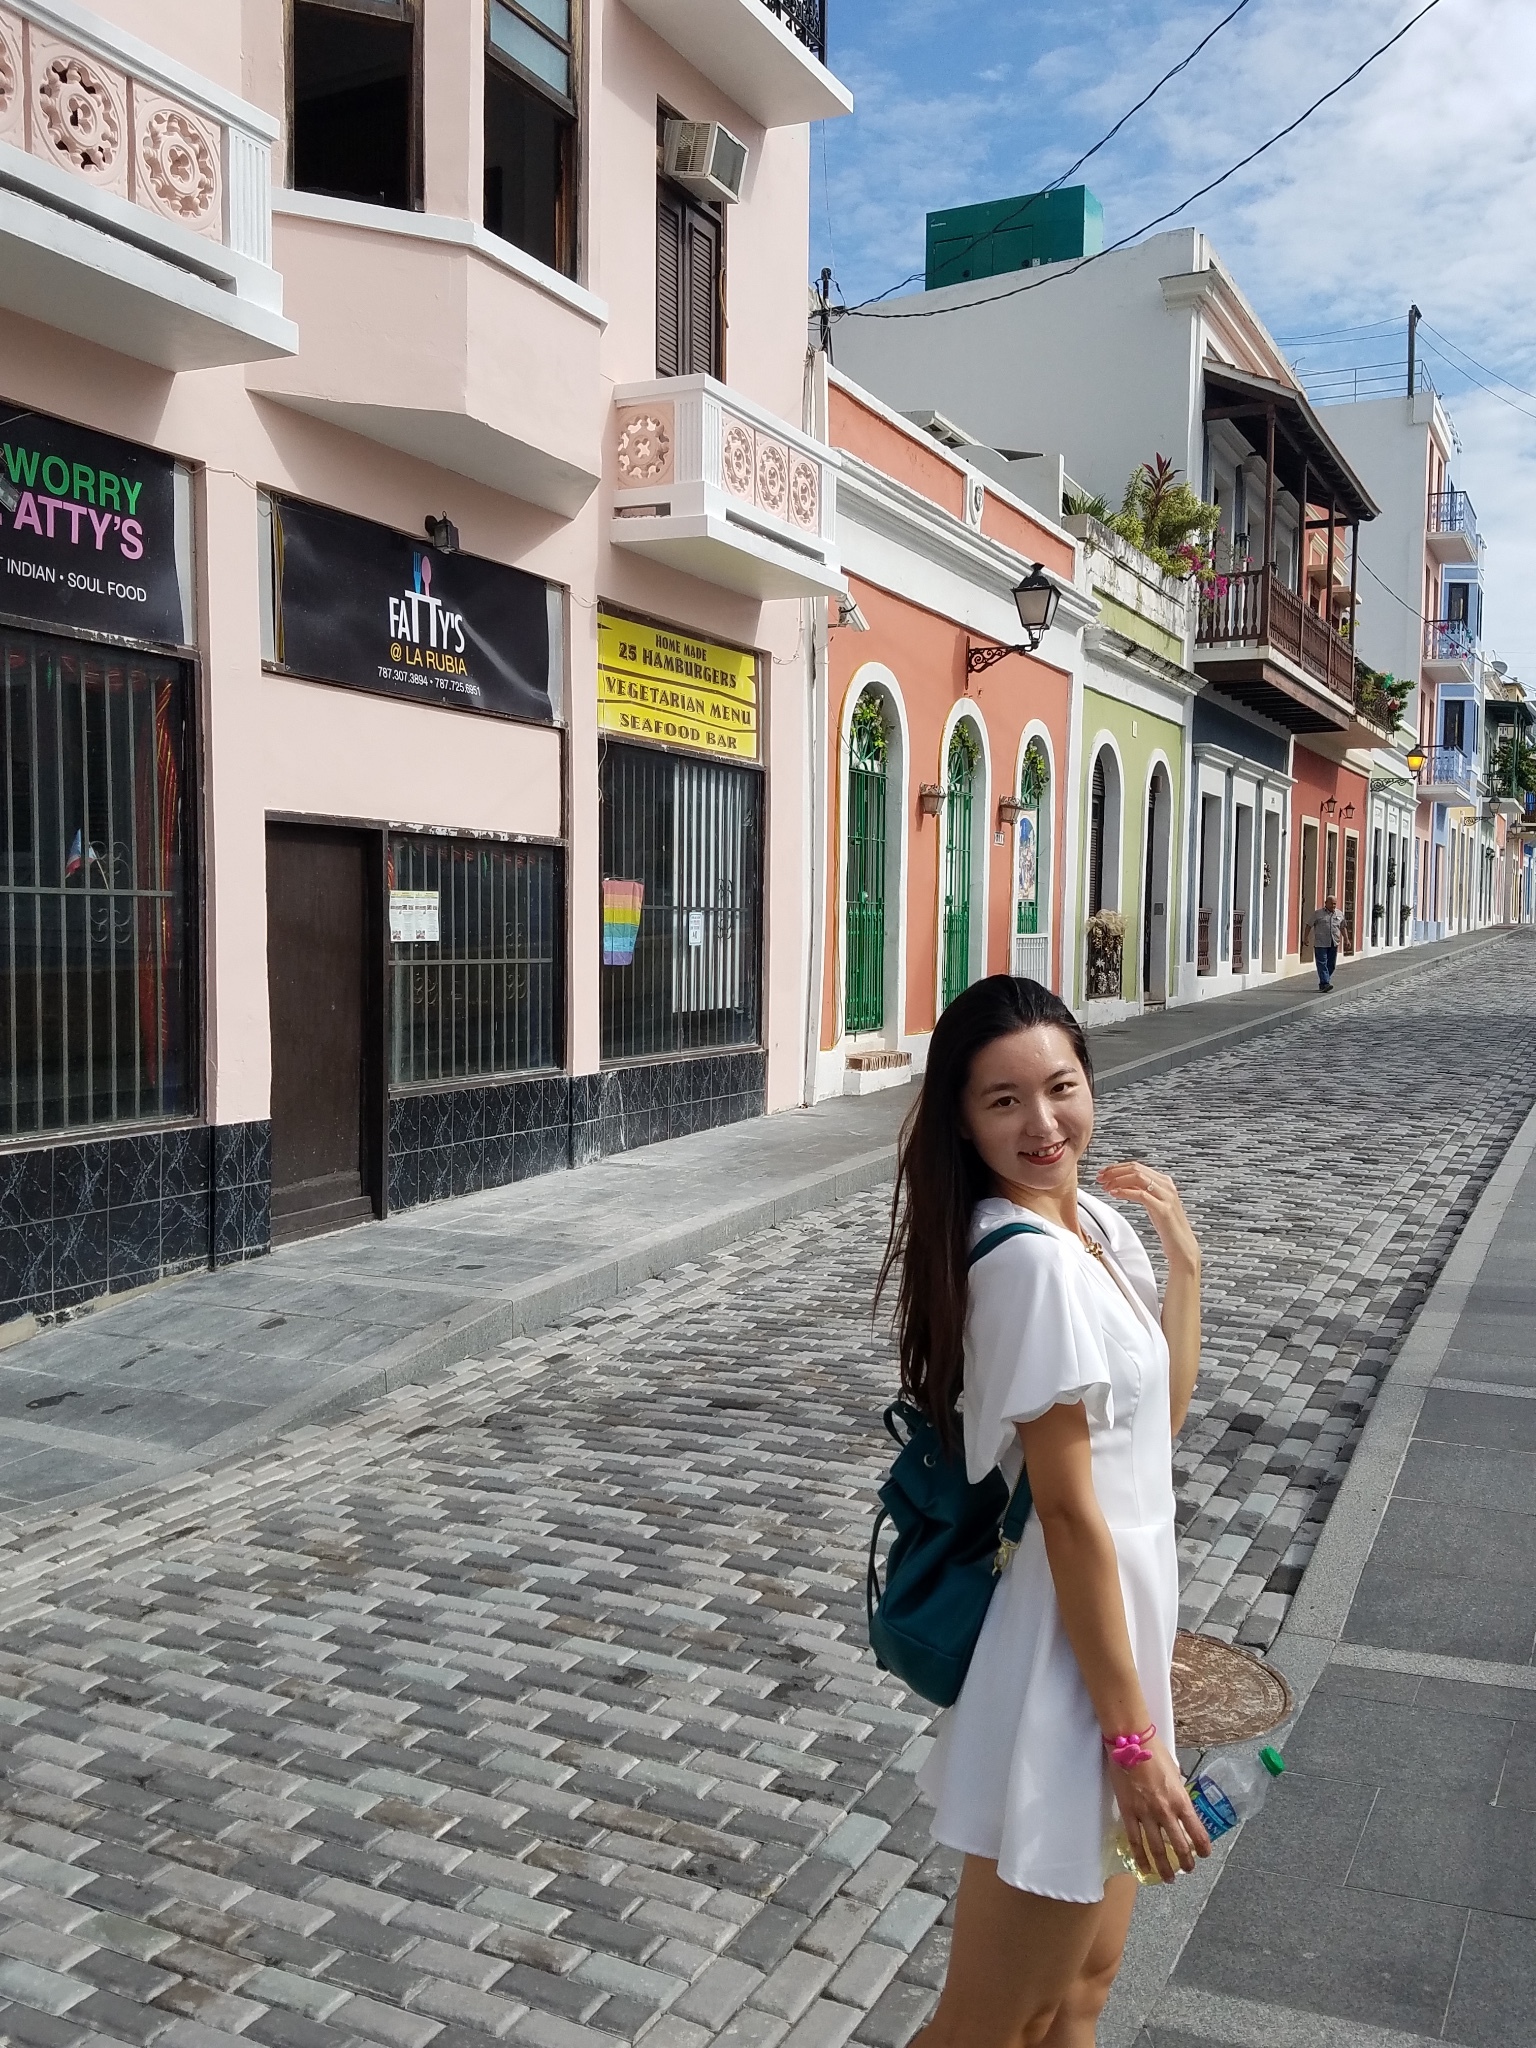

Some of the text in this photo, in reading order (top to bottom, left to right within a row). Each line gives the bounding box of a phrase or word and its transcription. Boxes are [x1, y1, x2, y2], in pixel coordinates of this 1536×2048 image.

[3, 443, 142, 515] WORRY
[0, 491, 143, 560] ATTY'S
[7, 559, 146, 602] INDIAN SOUL FOOD
[389, 590, 465, 654] FATTY'S
[391, 643, 467, 676] @ LA RUBIA
[618, 642, 736, 688] 25 HAMBURGERS
[656, 634, 707, 661] HOME MADE
[377, 666, 428, 686] 787.307.3894
[605, 676, 750, 725] VEGETARIAN MENU
[620, 712, 737, 749] SEAFOOD BAR
